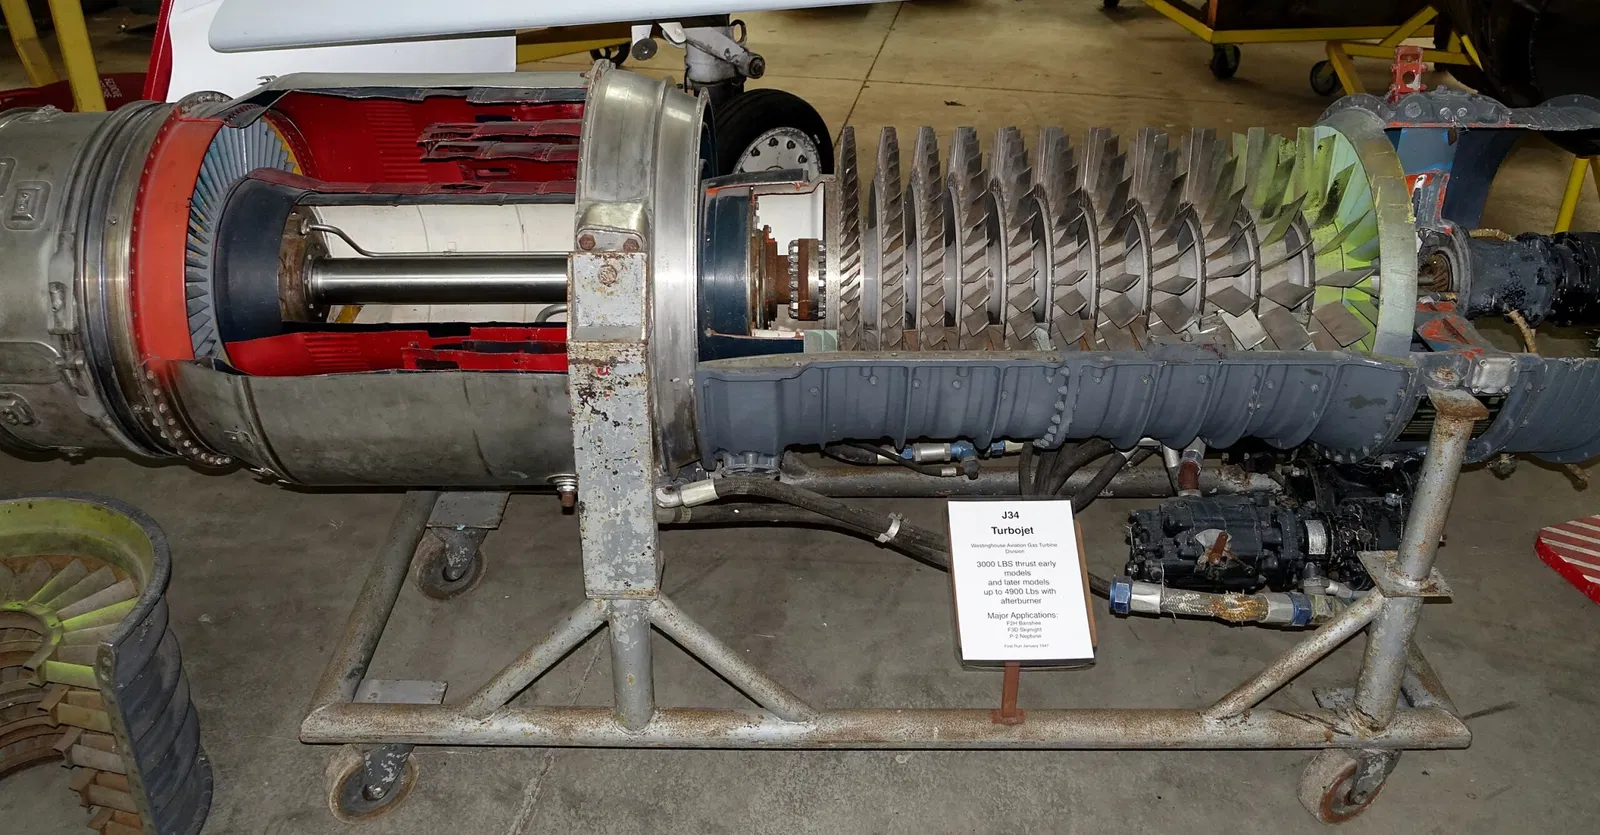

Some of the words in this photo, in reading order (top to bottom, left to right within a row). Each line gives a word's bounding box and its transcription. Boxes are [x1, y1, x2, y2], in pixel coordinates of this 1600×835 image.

[1001, 511, 1020, 520] J34
[991, 526, 1034, 536] Turbojet
[1038, 560, 1056, 568] early
[988, 612, 1009, 620] Major
[1010, 612, 1058, 620] Applications:
